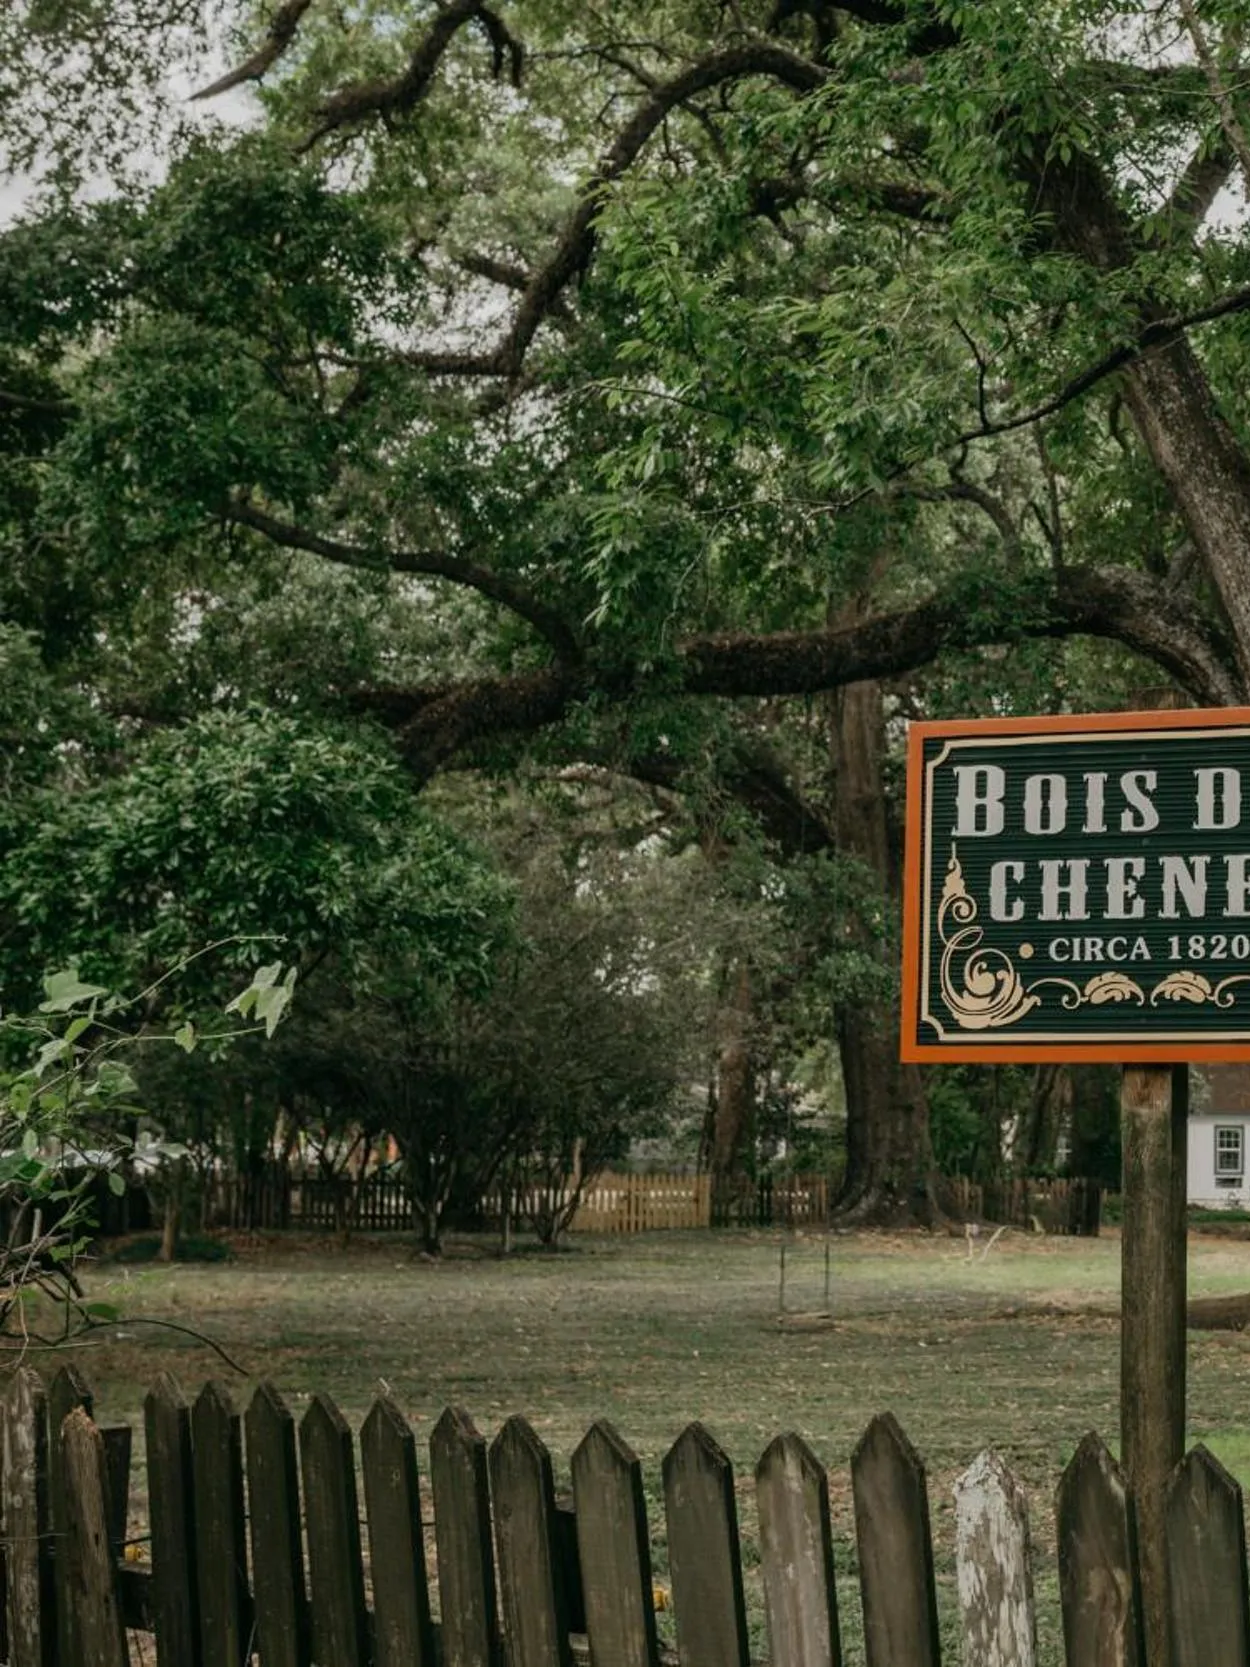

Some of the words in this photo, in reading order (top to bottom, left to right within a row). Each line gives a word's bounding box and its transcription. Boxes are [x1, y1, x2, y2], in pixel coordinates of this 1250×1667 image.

[951, 763, 1160, 837] BOIS
[1048, 936, 1151, 962] CIRCA
[1168, 934, 1250, 960] 1820
